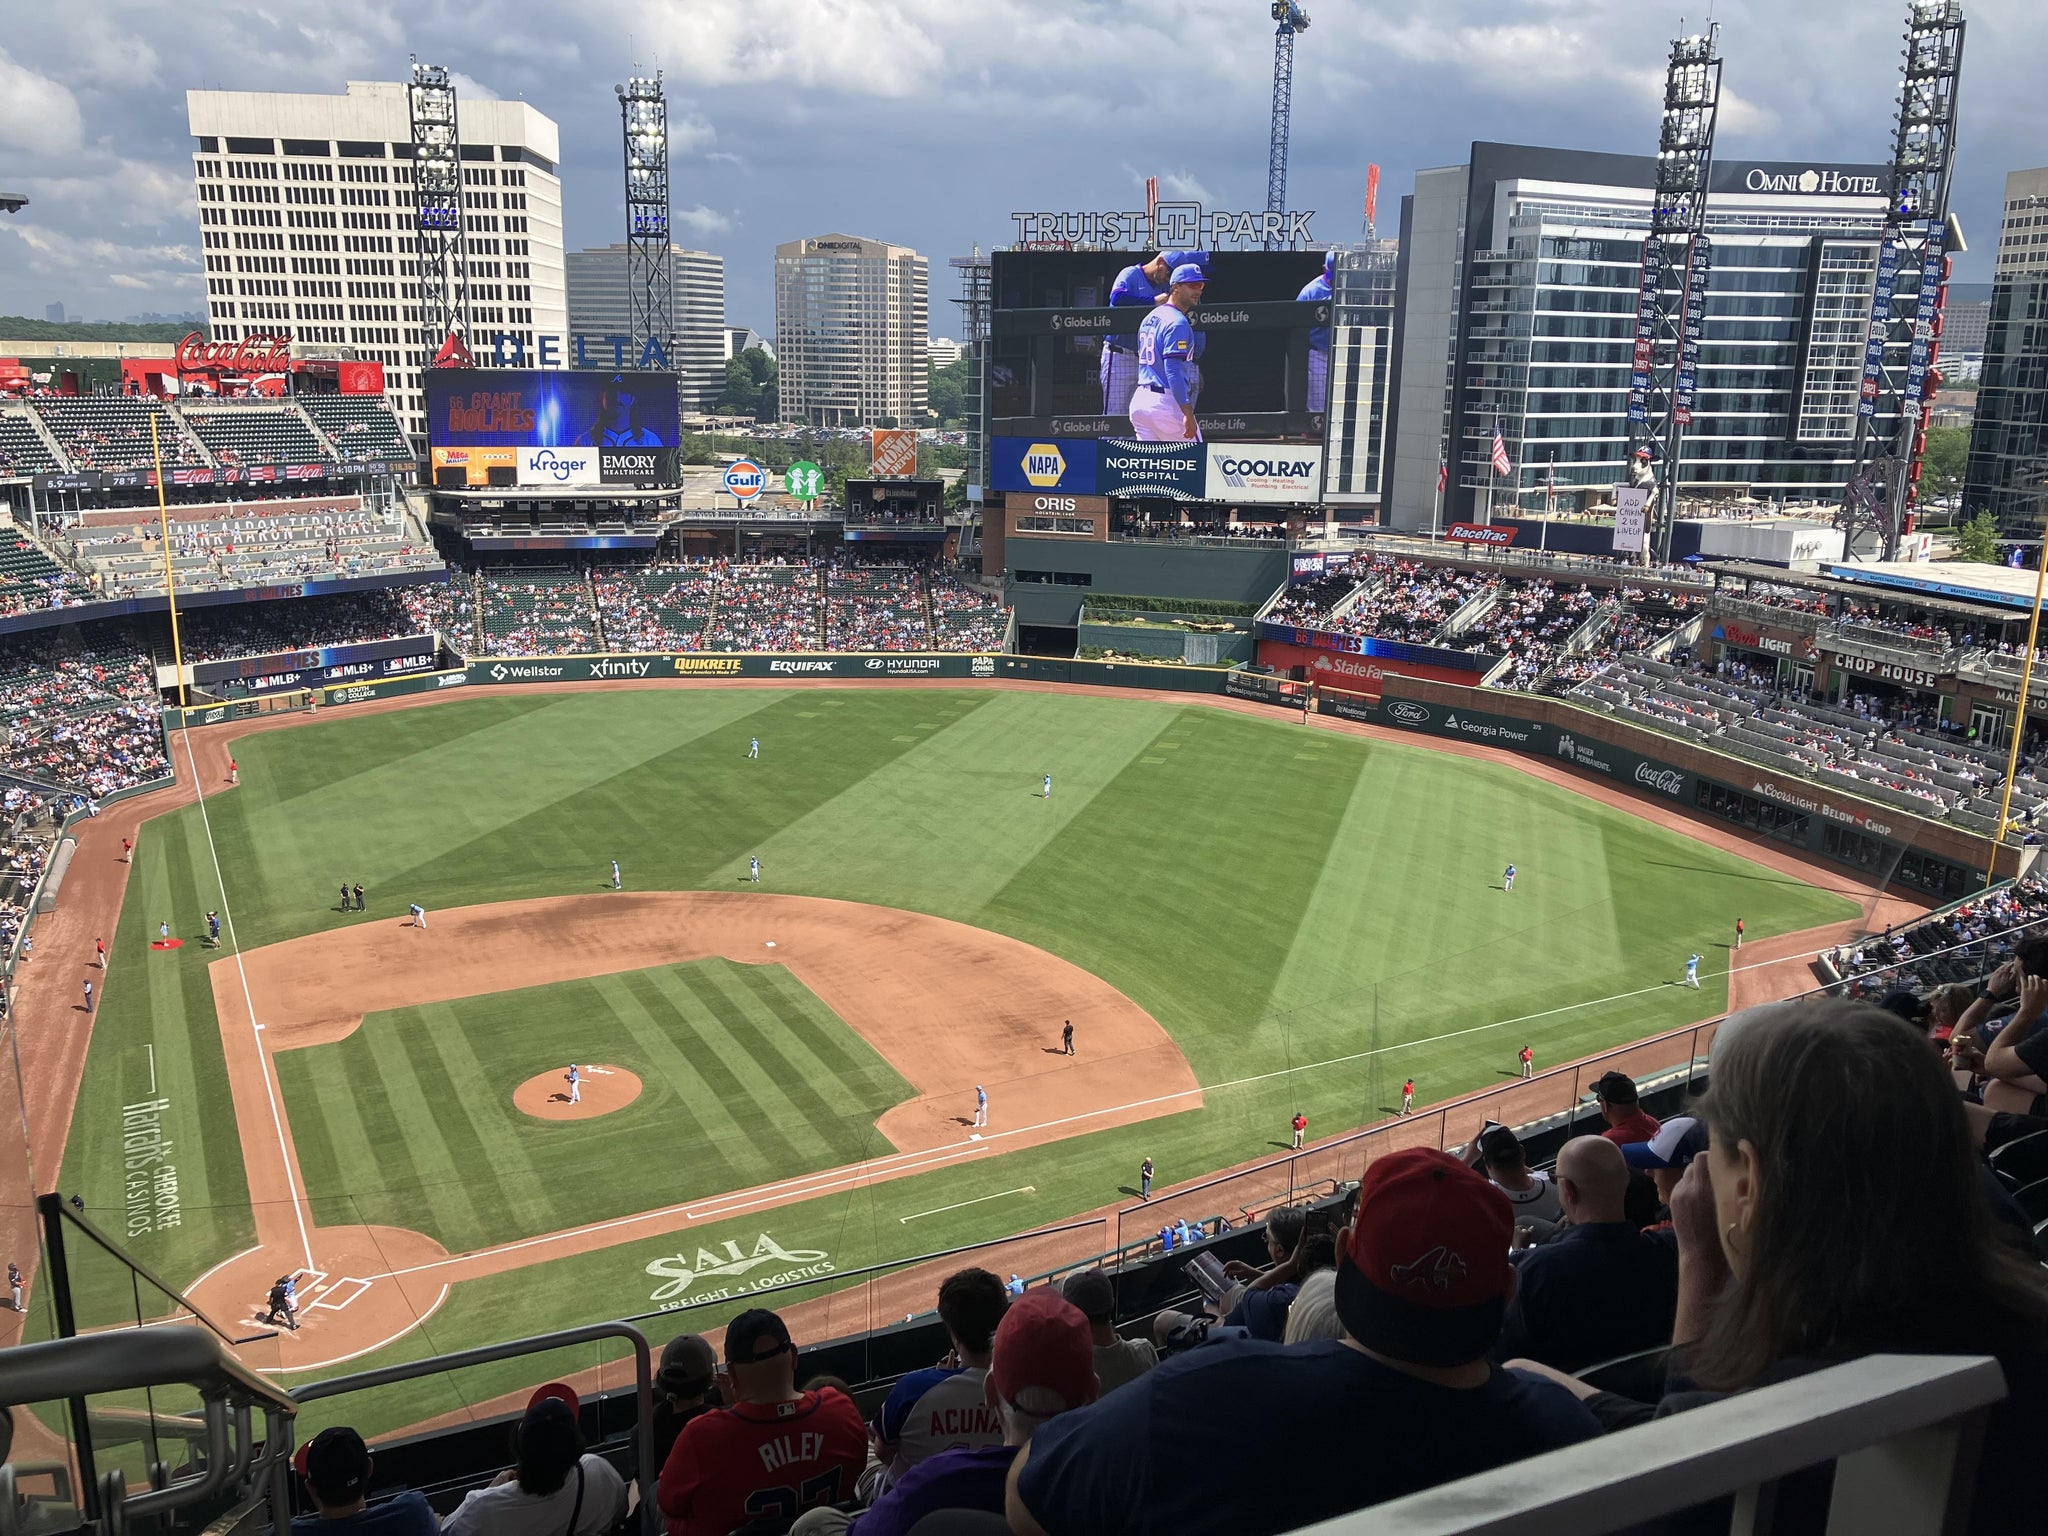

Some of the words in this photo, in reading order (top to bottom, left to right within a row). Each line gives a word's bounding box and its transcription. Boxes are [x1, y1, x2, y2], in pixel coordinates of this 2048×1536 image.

[1746, 168, 1799, 192] OMNI
[1820, 170, 1881, 194] HOTEL
[1012, 212, 1146, 243] TRUIST
[1211, 210, 1316, 243] PARK
[1064, 316, 1092, 328] Globe
[1094, 315, 1111, 327] Life
[1200, 312, 1229, 324] Globe
[1230, 310, 1249, 322] Life
[495, 334, 668, 368] DELTA
[1140, 332, 1155, 366] 28
[450, 396, 464, 409] 66
[472, 392, 521, 410] GRANT
[448, 408, 536, 432] HOLMES
[1063, 421, 1090, 432] Globe
[1092, 420, 1110, 432] Life
[1198, 419, 1226, 430] Globe
[1228, 419, 1246, 430] Life
[878, 436, 896, 452] THE
[447, 451, 468, 459] MEGA
[874, 432, 915, 474] HOME
[890, 447, 915, 474] DEPOT
[530, 450, 586, 480] Kroger
[603, 455, 656, 468] EMORY
[1028, 456, 1059, 474] NAPA
[1106, 457, 1197, 471] NORTHSIDE
[1222, 459, 1316, 478] COOLRAY
[727, 474, 761, 486] Gulf
[1122, 471, 1179, 481] HOSPITAL
[48, 480, 64, 488] 5.9
[1035, 497, 1076, 511] ORIS
[221, 519, 293, 544] AARON
[289, 512, 381, 538] TERRACE
[1451, 526, 1508, 542] RaceTrac
[1296, 629, 1307, 643] 66
[1725, 625, 1759, 647] Coors
[1759, 637, 1792, 654] LIGHT
[240, 662, 256, 675] 66
[402, 655, 432, 668] MLB+
[590, 659, 650, 678] xfinity
[674, 658, 742, 670] QUIKRETE
[770, 660, 834, 673] EQUIFAX
[887, 660, 939, 668] HYUNDAI
[972, 657, 993, 665] PAPA
[343, 664, 374, 675] MLB+
[510, 666, 563, 677] Wellstar
[1835, 654, 1876, 673] CHOP
[1881, 664, 1936, 688] HOUSE
[269, 674, 300, 686] MLB+
[348, 691, 376, 699] COLLEGE
[1343, 706, 1367, 716] National
[1395, 704, 1422, 719] Ford
[1461, 720, 1496, 736] Georgia
[1500, 726, 1528, 741] Power
[1578, 745, 1594, 757] KAISER
[1577, 754, 1610, 772] PERMANENTE
[1635, 762, 1685, 795] Coca-Cola
[1764, 782, 1791, 802] Coors
[1791, 794, 1818, 811] LIGHT
[1822, 804, 1854, 824] BELOW
[1865, 819, 1891, 836] CHOP
[1976, 872, 1986, 882] 325
[126, 1170, 151, 1237] CASINOS
[153, 1165, 181, 1230] CHEROKEE
[645, 1233, 828, 1300] SAIA
[660, 1288, 729, 1311] FREIGHT
[750, 1262, 835, 1290] LOGISTICS
[758, 1432, 824, 1473] RILEY
